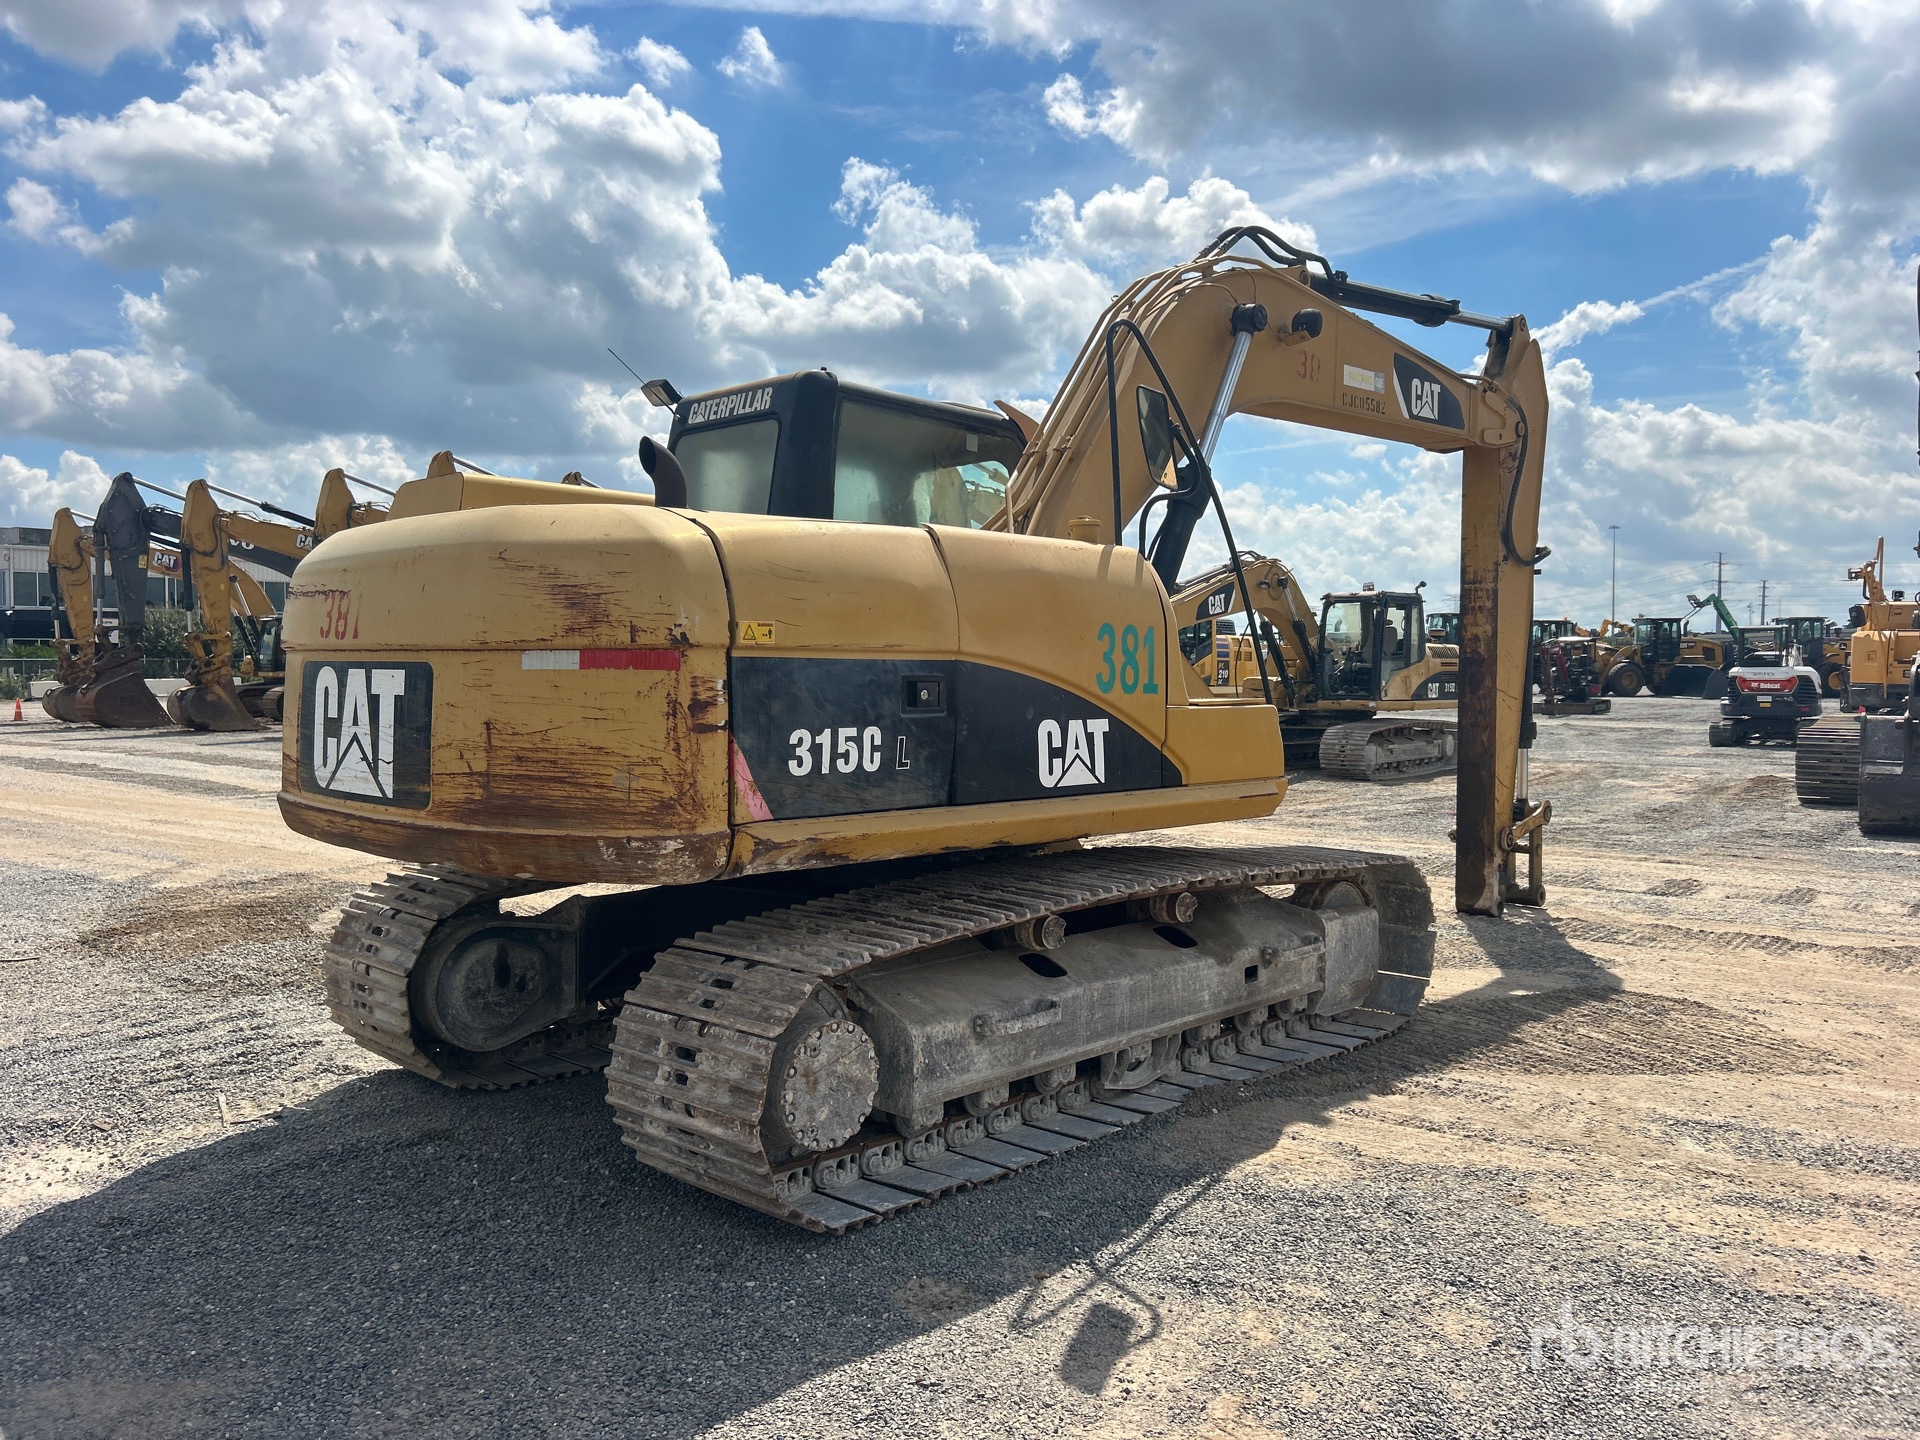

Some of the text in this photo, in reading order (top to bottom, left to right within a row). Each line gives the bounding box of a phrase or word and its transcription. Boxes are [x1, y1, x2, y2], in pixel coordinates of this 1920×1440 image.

[688, 387, 773, 424] CATERPILLAR
[1411, 378, 1441, 420] CAT
[153, 551, 177, 568] CAT
[296, 533, 313, 551] CA
[1208, 593, 1226, 615] CAT
[1096, 622, 1159, 696] 381
[1218, 670, 1229, 679] 210
[1427, 682, 1440, 699] CAT
[313, 666, 406, 799] CAT
[788, 725, 910, 778] 315C L
[1037, 718, 1110, 788] CAT
